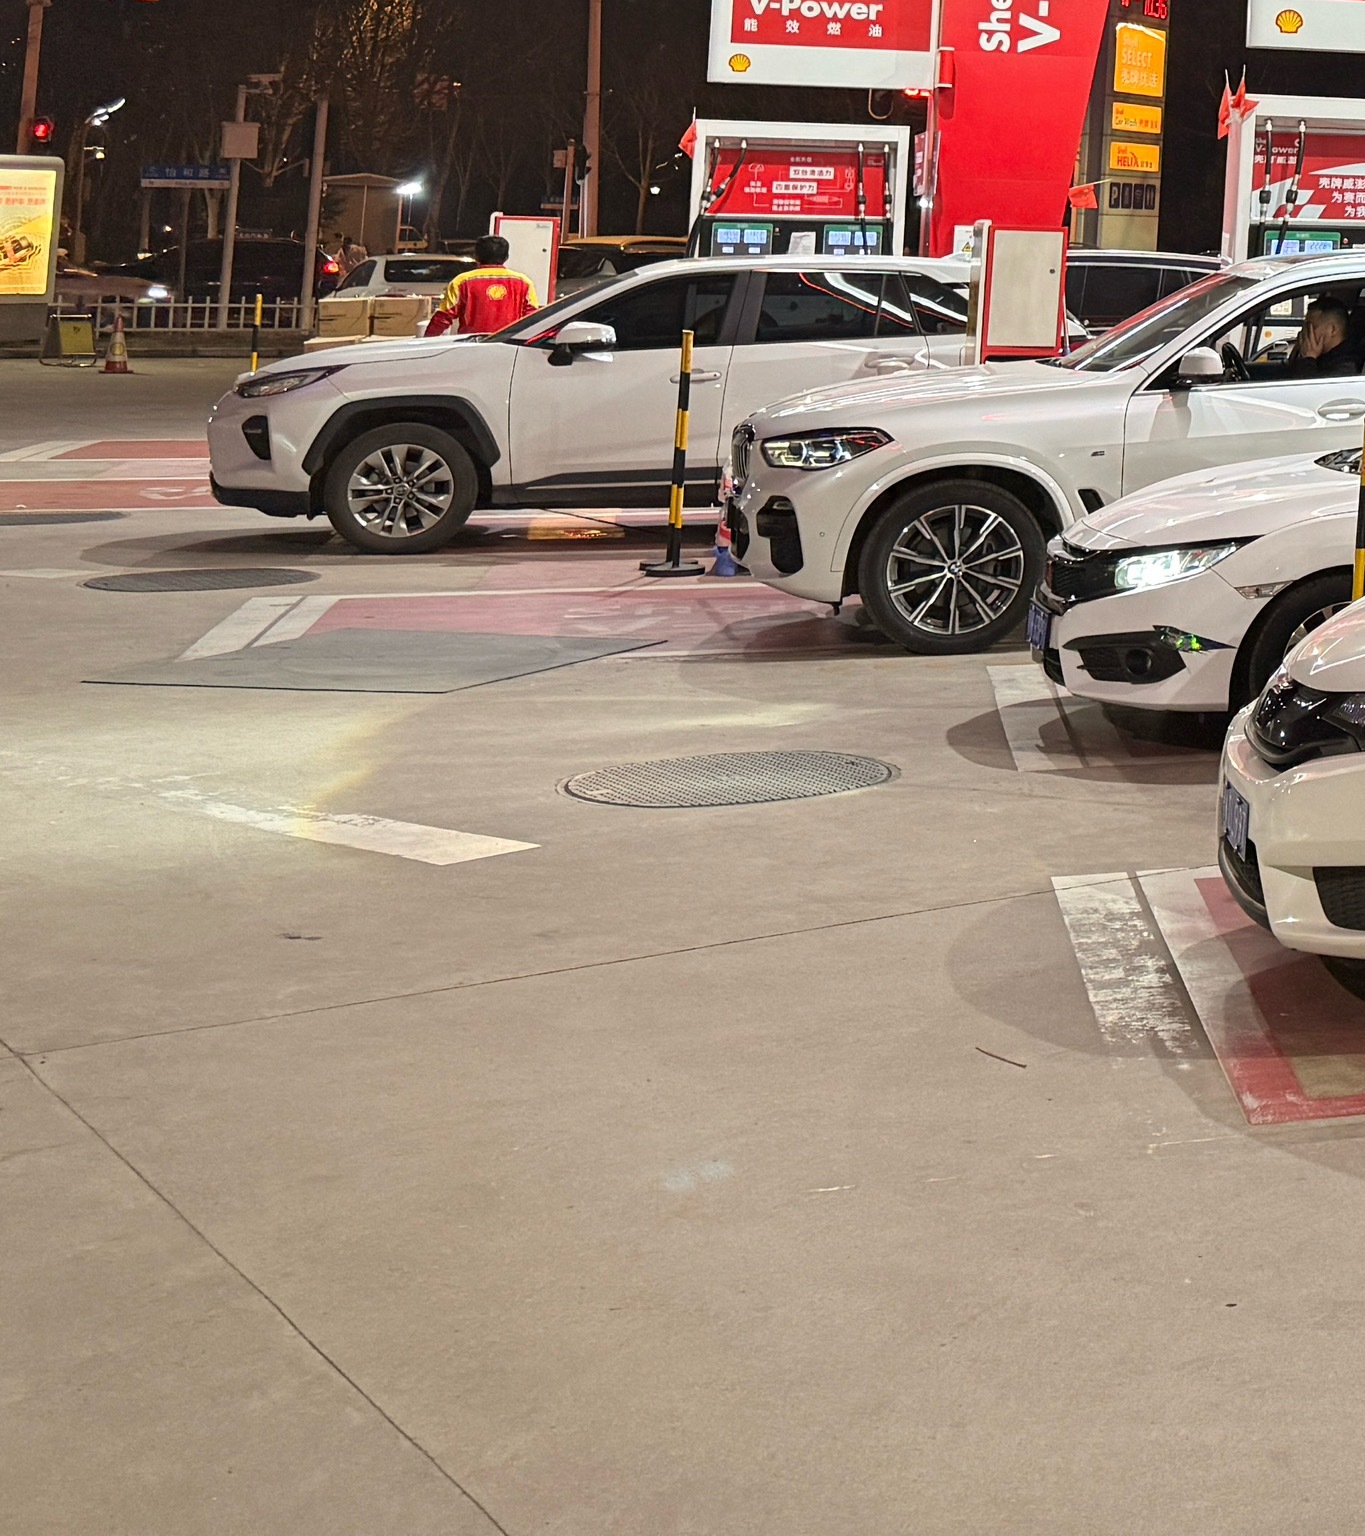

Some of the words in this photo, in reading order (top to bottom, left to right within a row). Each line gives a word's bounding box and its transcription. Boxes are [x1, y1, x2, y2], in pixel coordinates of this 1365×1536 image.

[744, 17, 883, 38] 能效燃油
[1122, 49, 1152, 68] SELECT
